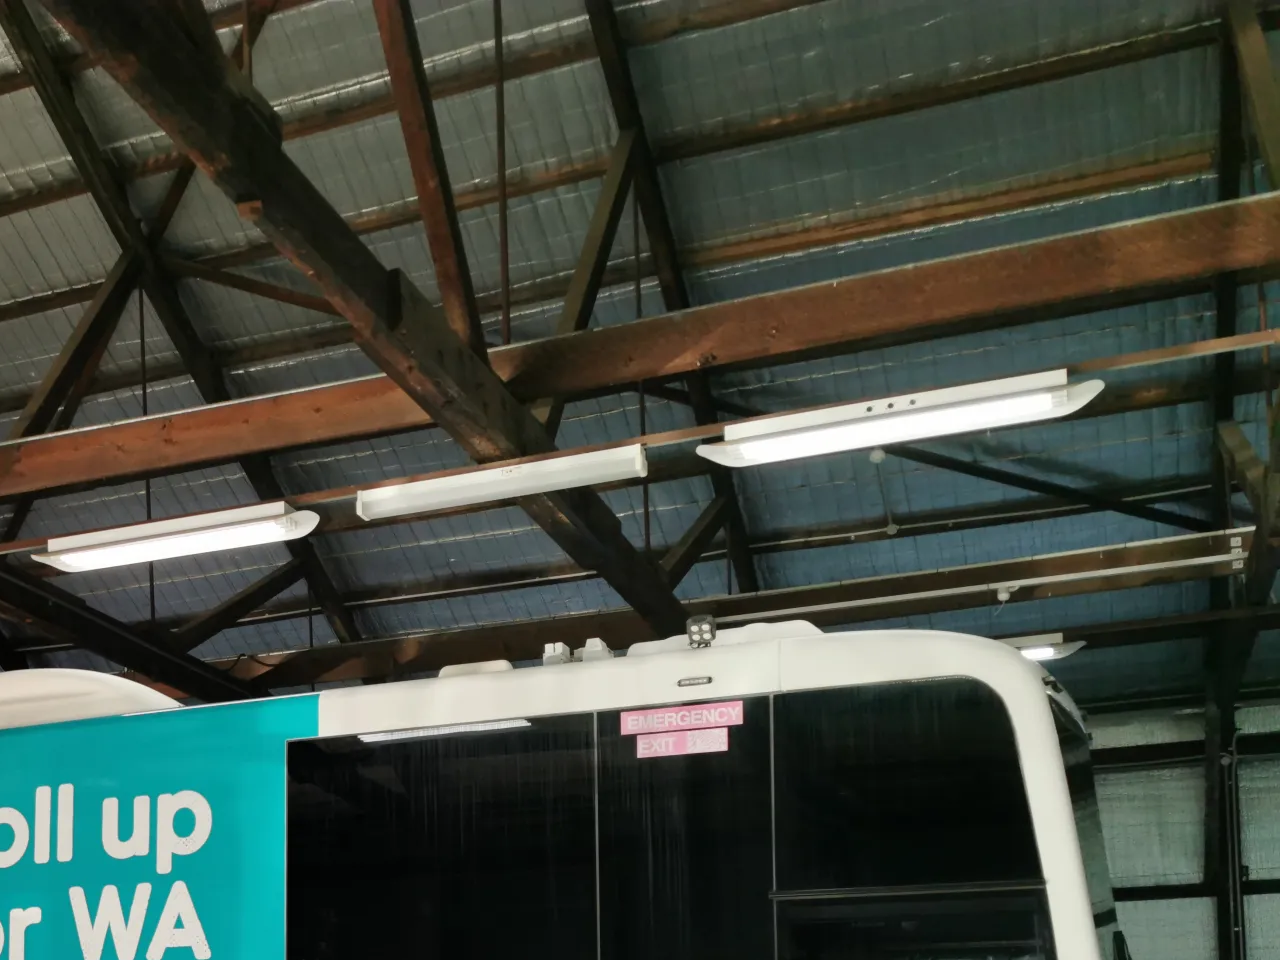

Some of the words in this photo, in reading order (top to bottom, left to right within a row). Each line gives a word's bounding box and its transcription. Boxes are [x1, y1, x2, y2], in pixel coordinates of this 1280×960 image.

[627, 707, 740, 730] EMERGENCY
[639, 737, 677, 753] EXIT
[102, 790, 212, 874] up
